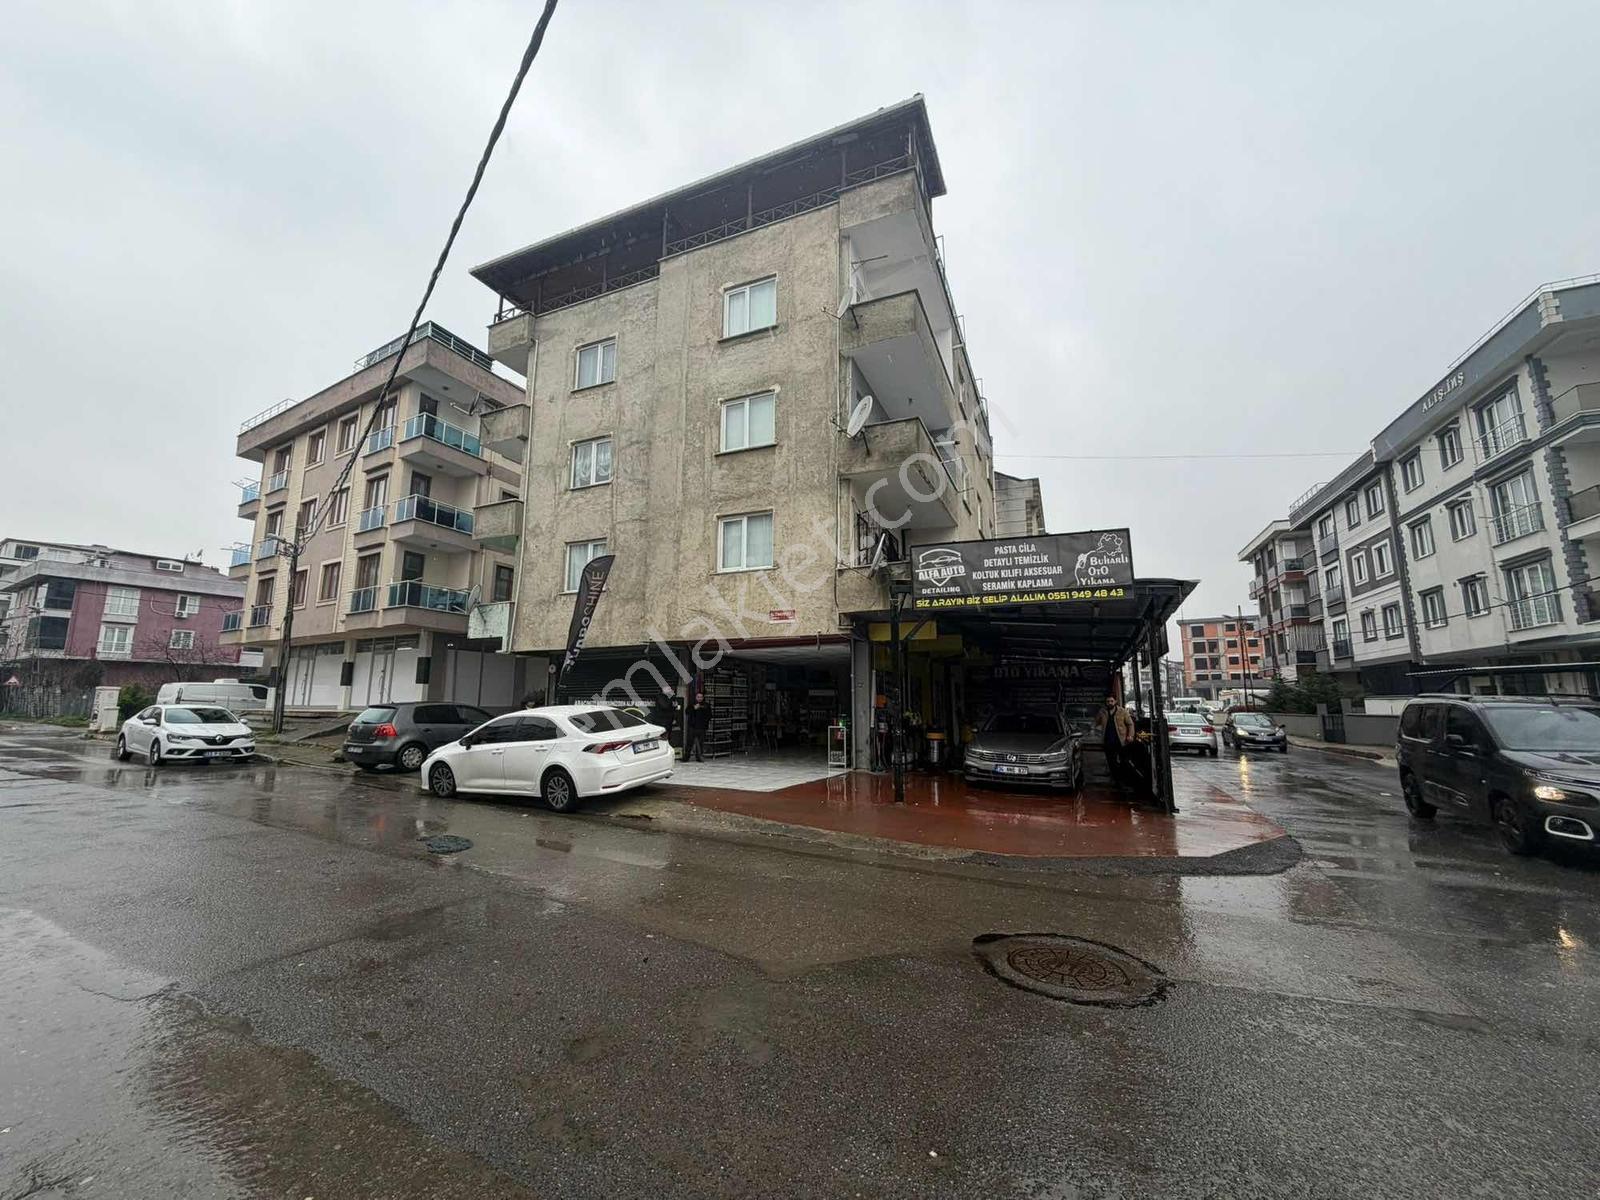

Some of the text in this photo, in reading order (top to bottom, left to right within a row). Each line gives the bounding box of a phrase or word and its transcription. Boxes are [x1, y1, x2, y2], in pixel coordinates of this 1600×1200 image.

[994, 545, 1017, 555] PASTA
[983, 553, 1049, 567] DETAYLI TEMİZLİK
[918, 565, 965, 581] ALFA AUTO
[972, 565, 1063, 580] KOLTUK KILIFI AKSESUAR
[921, 586, 961, 595] DETAILING
[982, 578, 1054, 591] SERAMİK KAPLAMA
[915, 588, 1124, 608] SİZ ARAYIN BİZ GELİP ALALIM 0551 949 48 43
